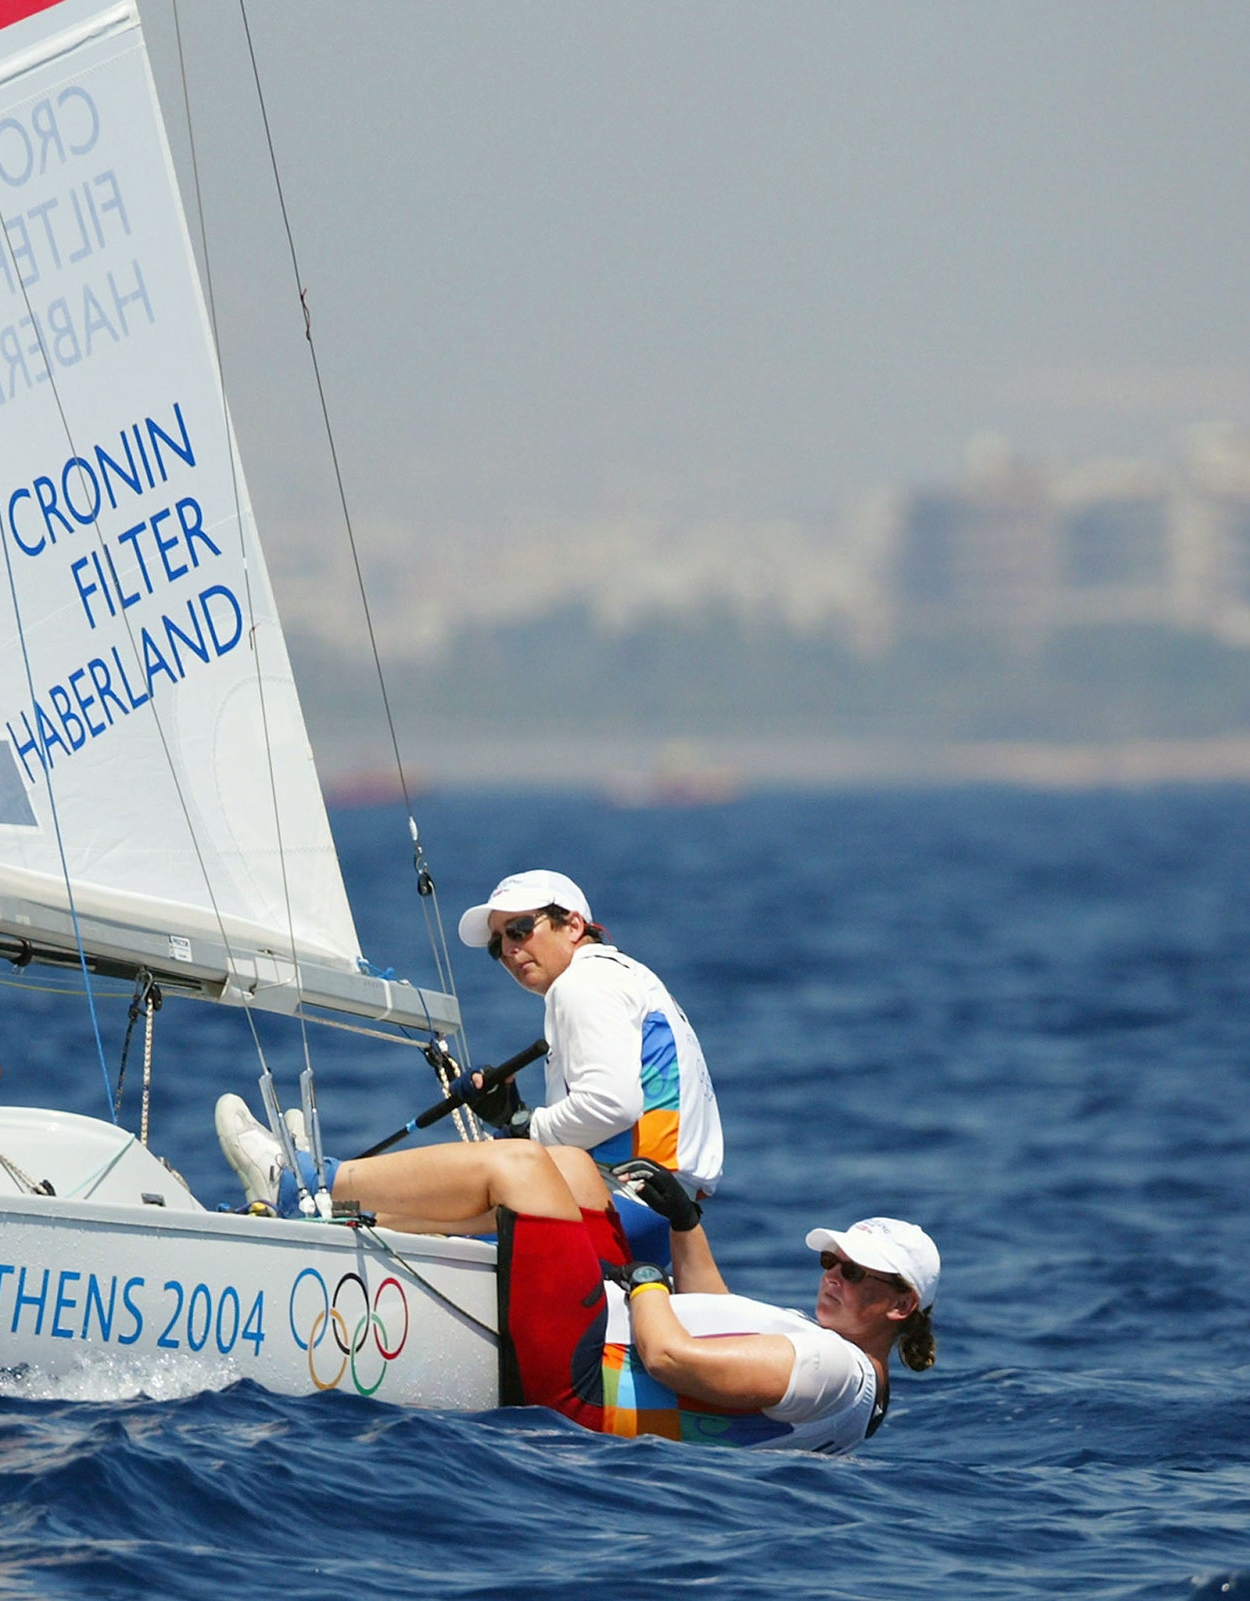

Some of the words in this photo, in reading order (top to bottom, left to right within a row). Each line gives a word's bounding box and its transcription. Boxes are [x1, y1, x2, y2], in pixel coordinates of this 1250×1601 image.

[8, 402, 196, 557] CRONIN
[70, 497, 222, 629] FILTER
[6, 585, 243, 784] HABERLAND
[157, 1280, 266, 1357] 2004
